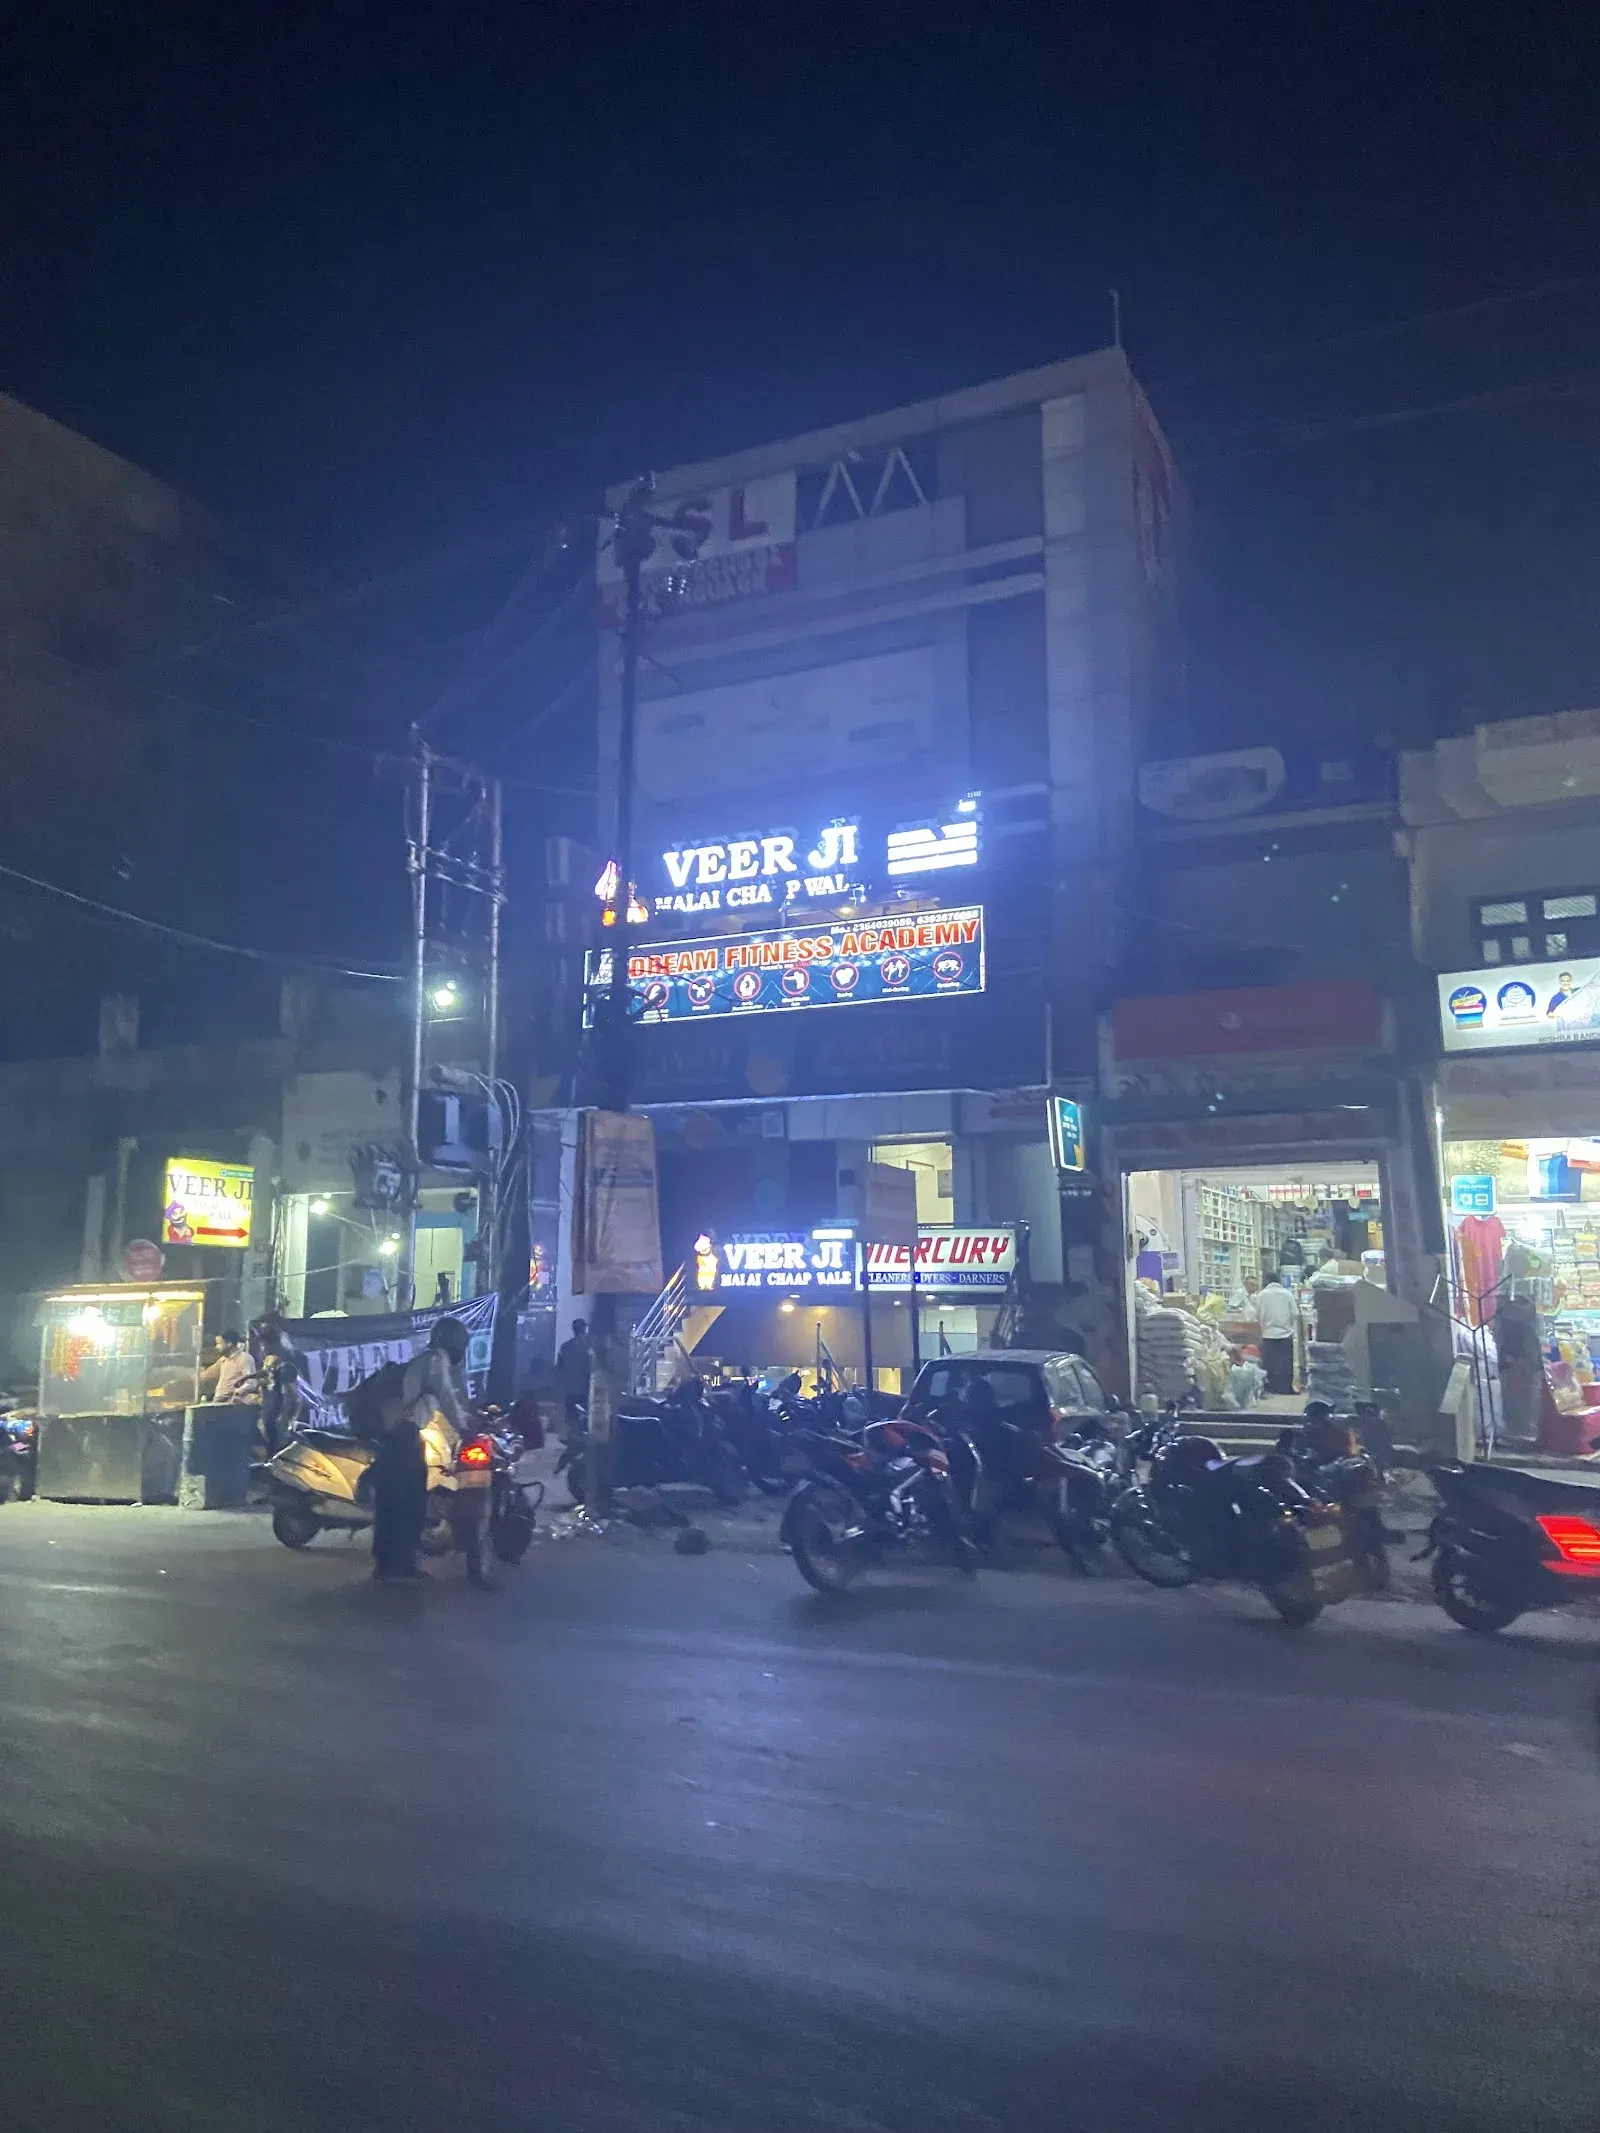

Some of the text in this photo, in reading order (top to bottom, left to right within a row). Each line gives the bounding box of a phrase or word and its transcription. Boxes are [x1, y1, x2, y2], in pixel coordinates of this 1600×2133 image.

[663, 824, 858, 888] VEER JI
[726, 876, 801, 908] CHAP
[628, 948, 718, 979] DREAM
[725, 935, 833, 967] FITNESS
[841, 919, 980, 956] ACADEMY
[167, 1173, 253, 1200] VEER JI
[723, 1241, 844, 1270] VEER JI
[766, 1271, 812, 1286] CHAAP
[919, 1272, 951, 1284] DYERS
[958, 1272, 1006, 1284] DARNERS
